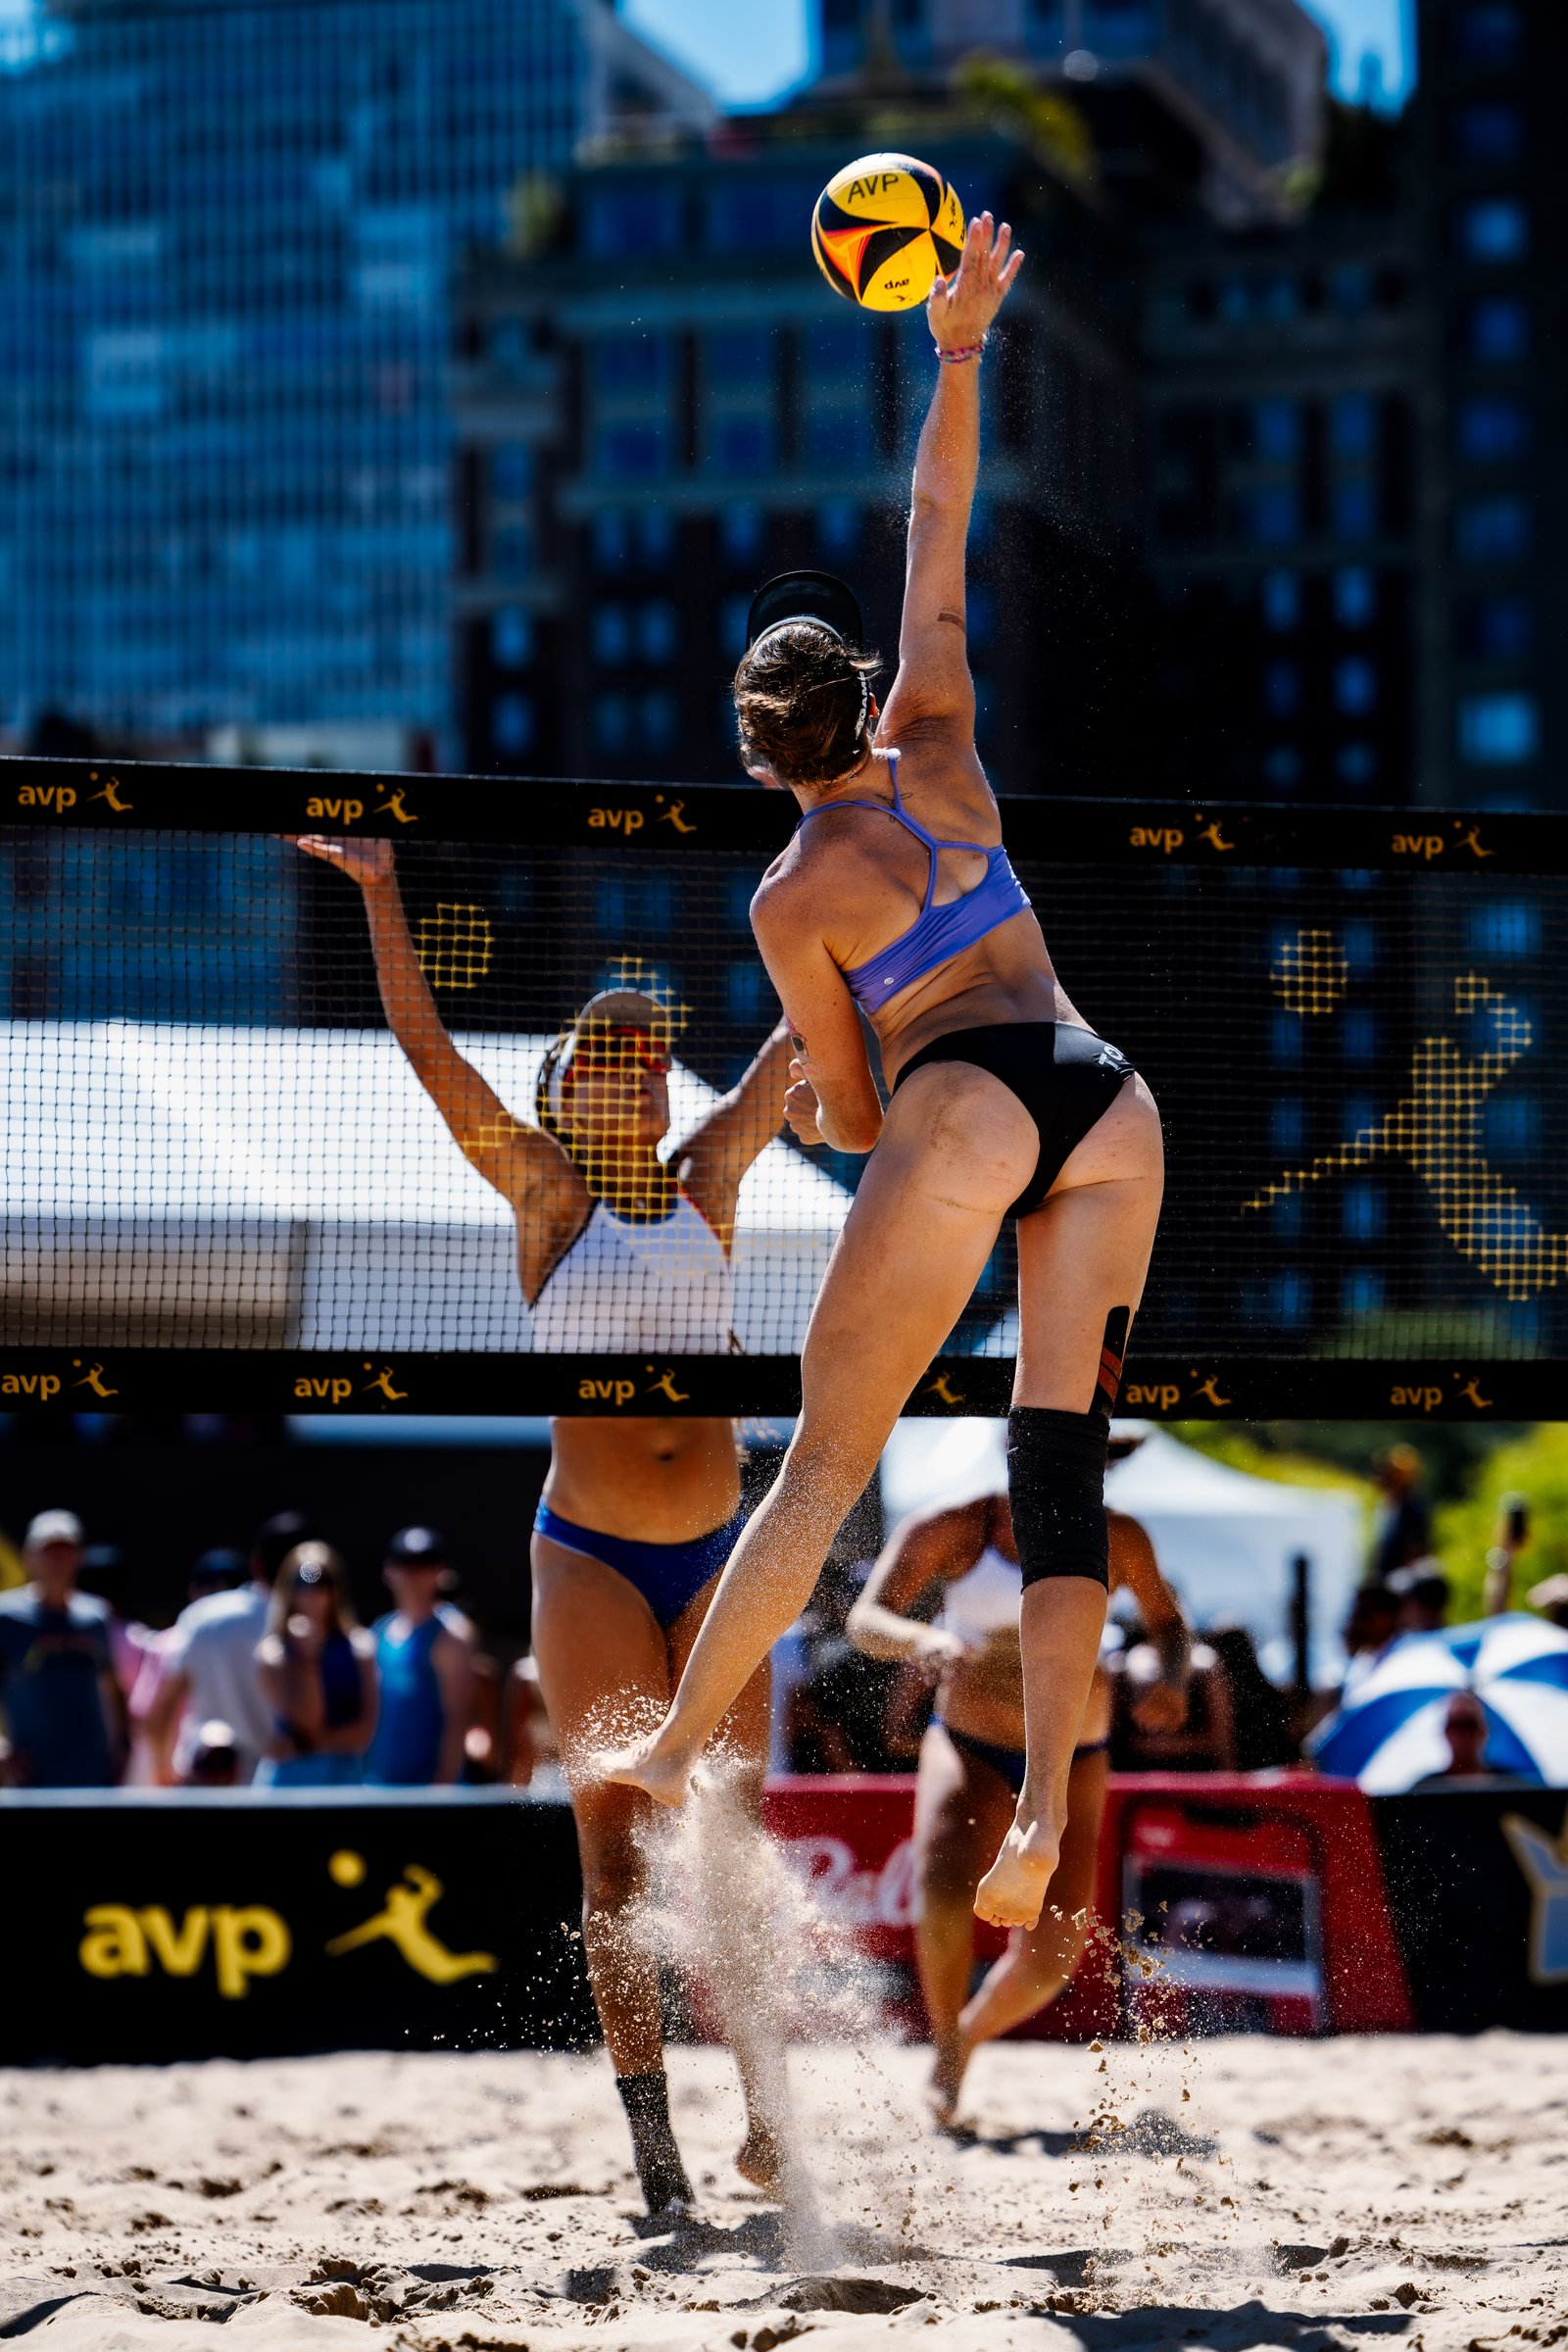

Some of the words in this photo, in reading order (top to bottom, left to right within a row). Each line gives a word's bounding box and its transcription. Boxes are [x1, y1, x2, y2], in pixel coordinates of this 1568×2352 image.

[847, 172, 899, 204] AVP
[884, 278, 909, 290] avp
[18, 786, 76, 813] avp
[306, 797, 364, 825] avp
[588, 808, 644, 836] avp
[1130, 827, 1184, 854] avp
[1392, 835, 1444, 860] avp
[1, 1375, 61, 1401] avp
[294, 1378, 352, 1404] avp
[578, 1380, 635, 1406] avp
[1126, 1385, 1180, 1410] avp
[1391, 1387, 1443, 1411] avp
[78, 1904, 291, 1998] avp
